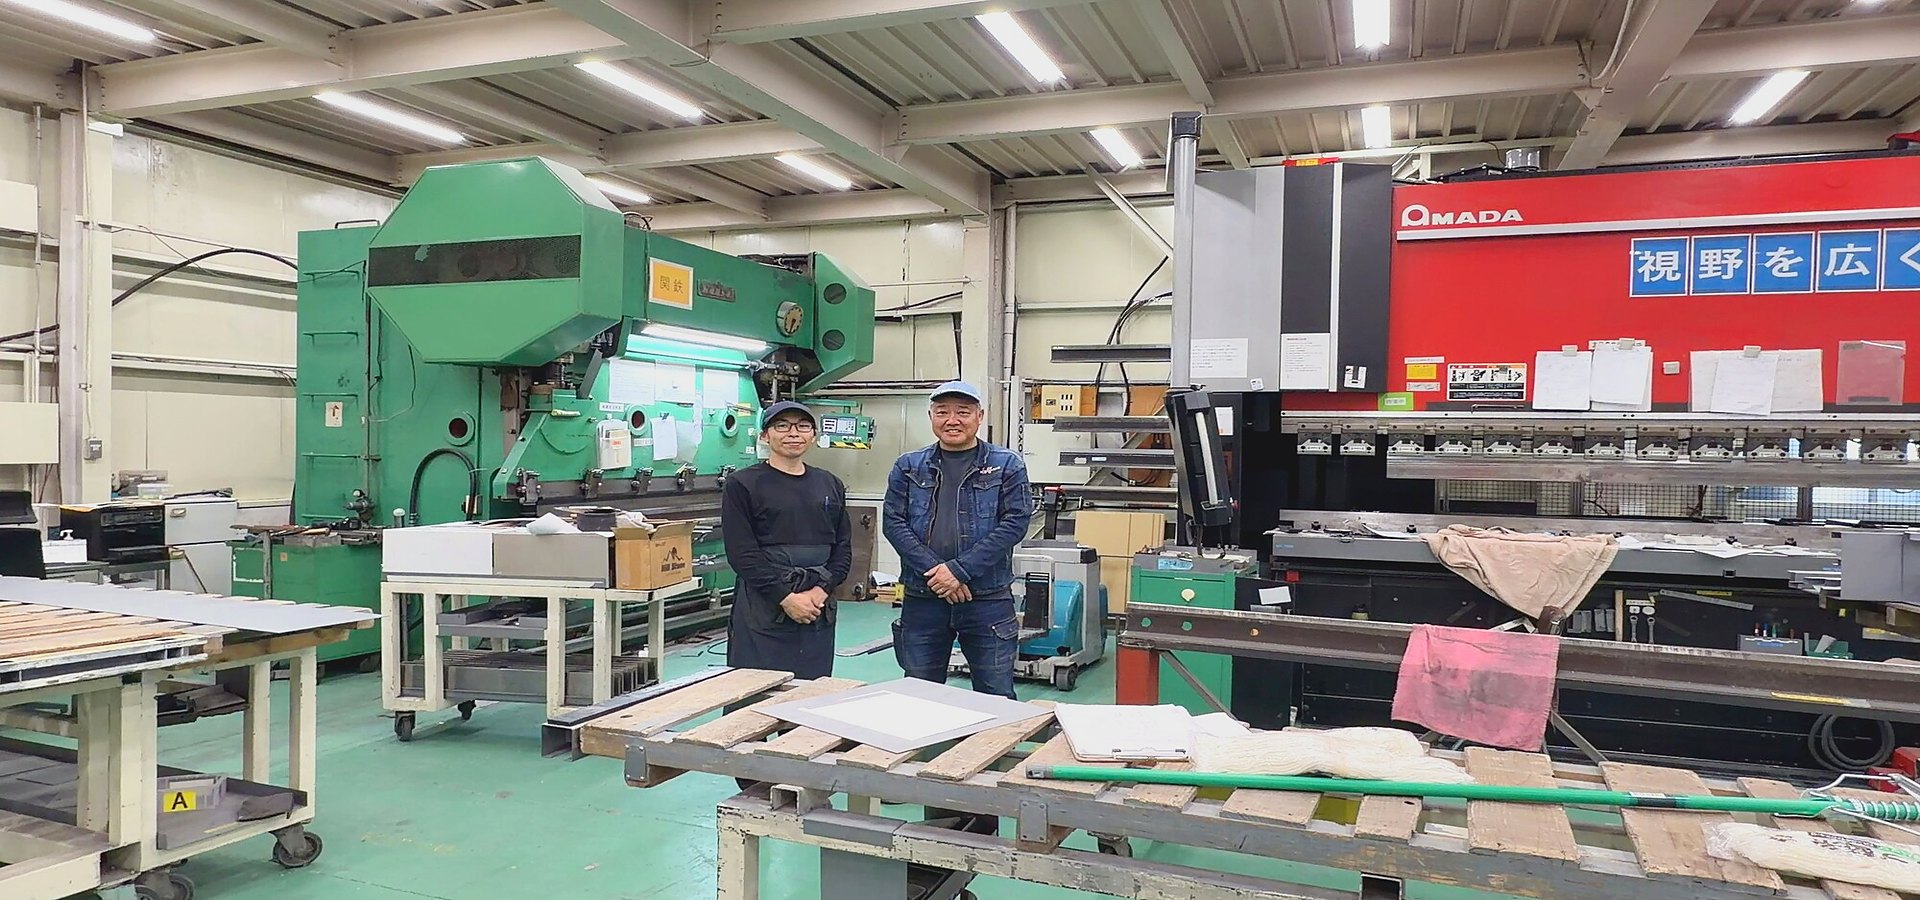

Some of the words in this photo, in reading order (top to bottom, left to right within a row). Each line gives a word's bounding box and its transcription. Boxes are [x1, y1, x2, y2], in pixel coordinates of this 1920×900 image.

[1401, 204, 1524, 227] AMADA
[1637, 242, 1920, 283] 視野を広く
[171, 791, 188, 810] A
